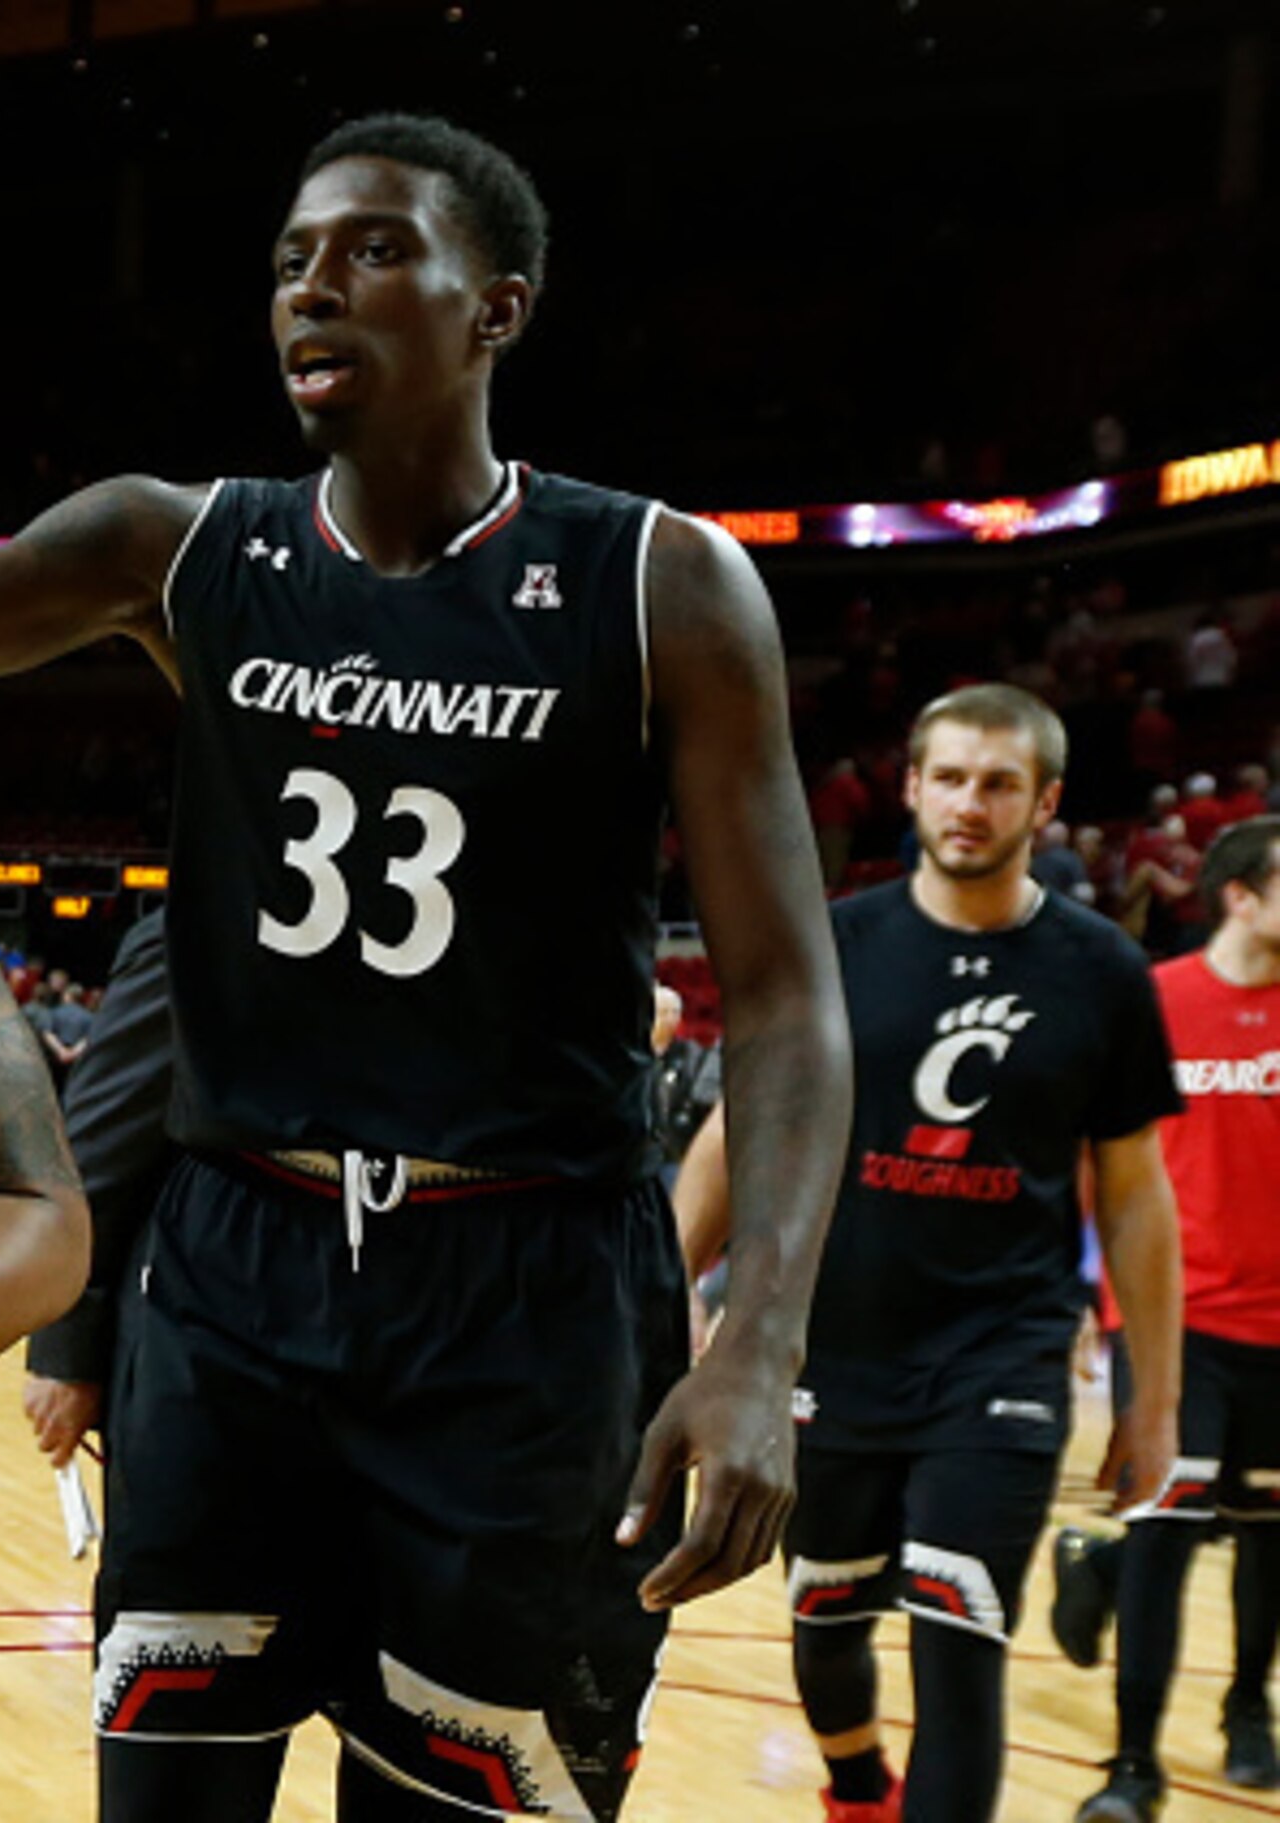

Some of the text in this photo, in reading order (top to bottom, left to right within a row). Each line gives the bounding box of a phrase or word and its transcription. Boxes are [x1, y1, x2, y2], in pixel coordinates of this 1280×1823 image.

[1159, 443, 1268, 507] IOWA
[228, 656, 562, 742] CINCINNATI
[256, 767, 468, 978] 33
